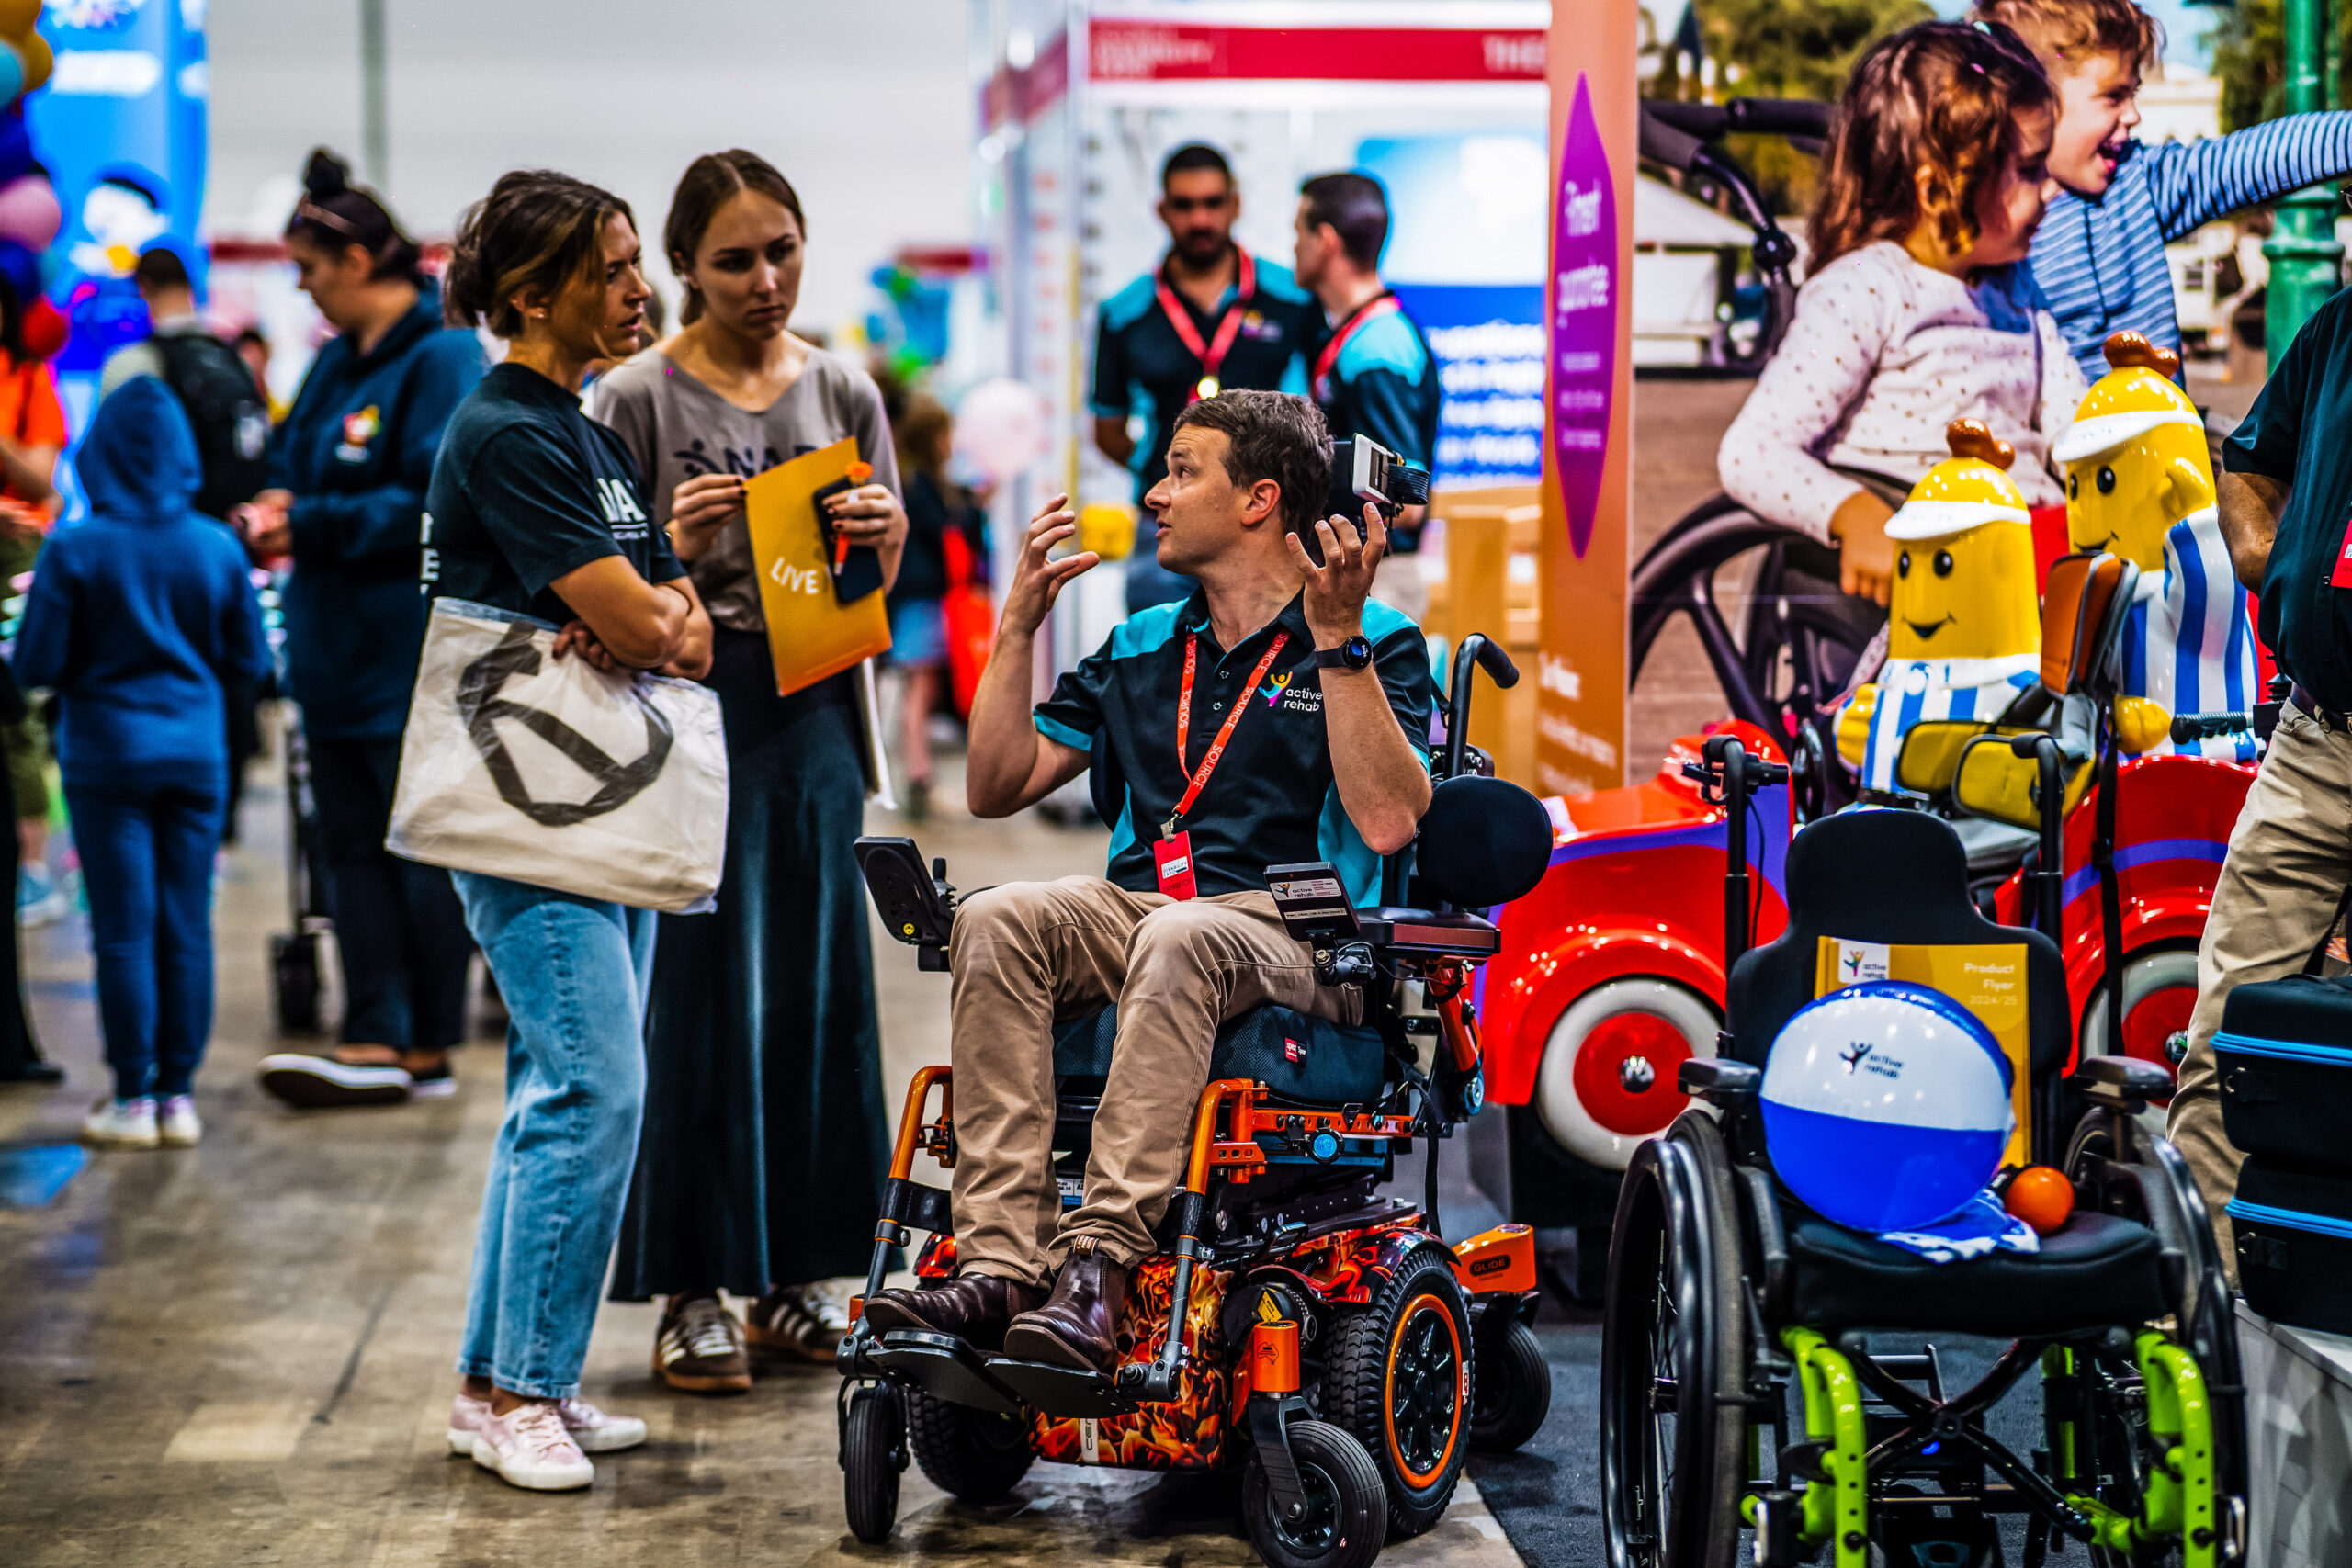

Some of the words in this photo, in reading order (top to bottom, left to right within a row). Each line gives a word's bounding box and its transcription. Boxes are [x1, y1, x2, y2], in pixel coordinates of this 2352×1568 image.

[771, 558, 818, 594] LIVE
[1257, 633, 1288, 671] SOURCE
[1285, 688, 1323, 700] active
[1178, 688, 1192, 728] SOURCE
[1225, 686, 1254, 729] SOURCE
[1283, 700, 1320, 712] rehab
[1193, 744, 1223, 789] SOURCE
[1964, 963, 2015, 974] Product
[1984, 979, 2015, 992] Flyer
[1970, 995, 2017, 1006] 2024/25
[1473, 1258, 1506, 1272] GLIDE
